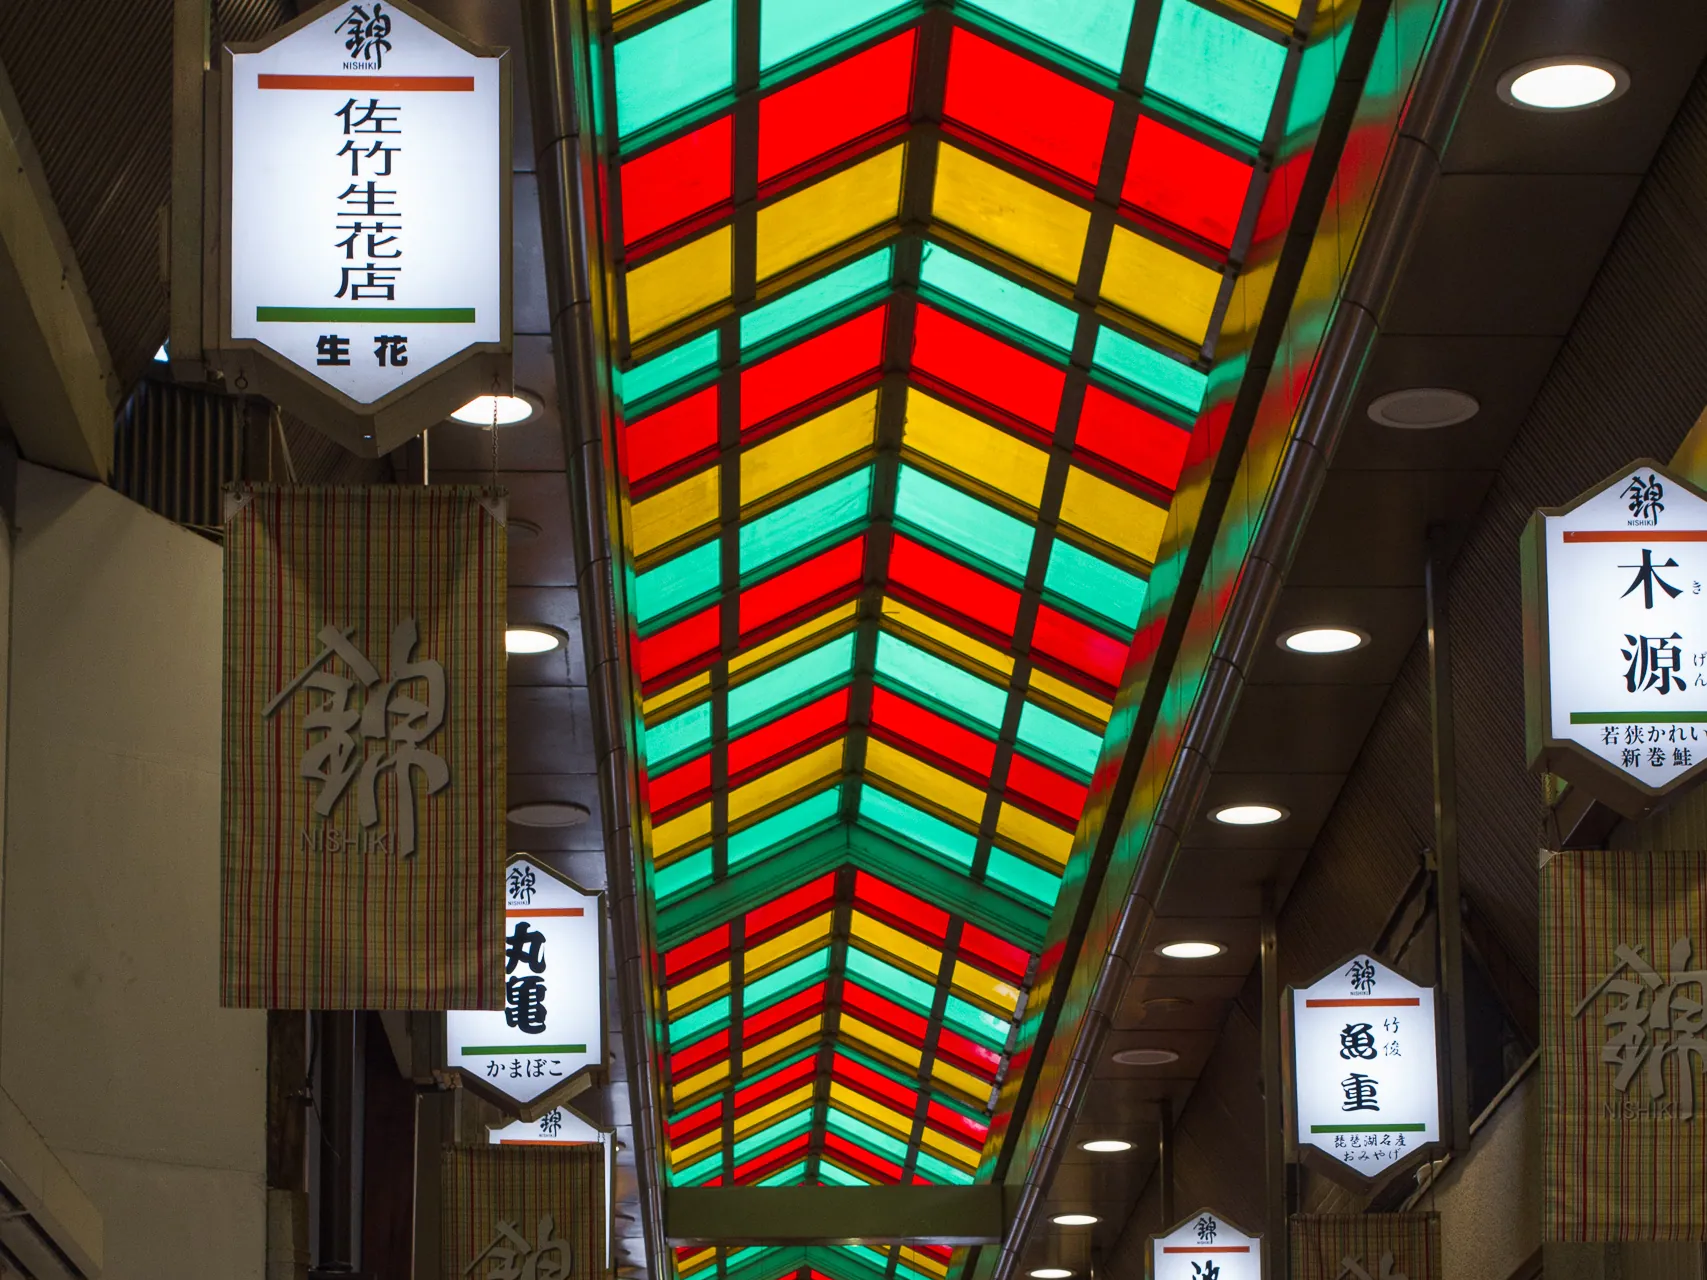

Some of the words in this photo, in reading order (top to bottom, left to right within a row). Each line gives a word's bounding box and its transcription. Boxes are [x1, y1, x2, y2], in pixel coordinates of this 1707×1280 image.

[334, 4, 392, 70] 錦
[343, 61, 378, 70] NISHIKI
[334, 98, 402, 300] 佐竹生花店
[316, 335, 408, 367] 生花
[1620, 474, 1665, 526] 錦
[1617, 548, 1687, 695] 木源
[261, 615, 450, 858] 錦
[1600, 724, 1707, 746] 若狭かれい
[1621, 746, 1693, 768] 新巻鮭
[300, 827, 396, 855] NISHIKI
[506, 866, 537, 905] 錦
[506, 921, 547, 1035] 丸亀
[1345, 960, 1376, 995] 錦
[1571, 936, 1707, 1121] 錦
[486, 1058, 563, 1079] かまぼこ
[1339, 1023, 1380, 1112] 魚重
[539, 1107, 562, 1138] 錦
[1334, 1134, 1407, 1149] 琵琶湖名産
[1343, 1150, 1401, 1163] おみやげ
[1193, 1217, 1217, 1244] 錦
